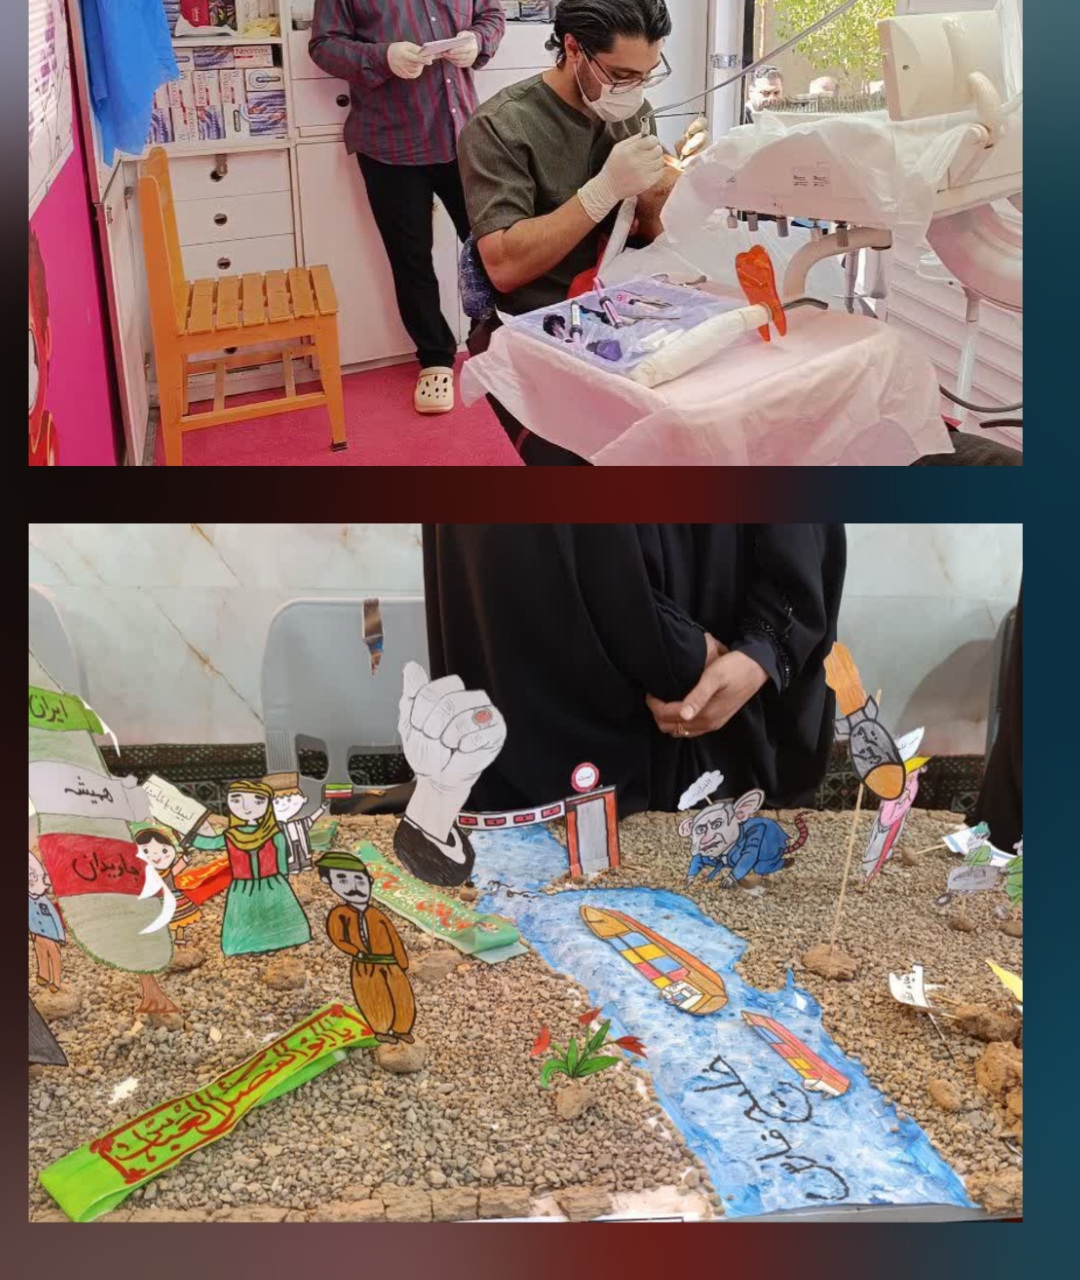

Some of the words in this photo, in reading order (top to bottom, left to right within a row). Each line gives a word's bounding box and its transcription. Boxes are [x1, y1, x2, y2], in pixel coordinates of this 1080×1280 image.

[235, 47, 269, 55] Neomax
[30, 694, 69, 724] ایران
[63, 775, 115, 805] همیشه
[72, 851, 142, 884] جاویدان
[693, 1054, 814, 1124] خلیج
[755, 1128, 851, 1201] فارس
